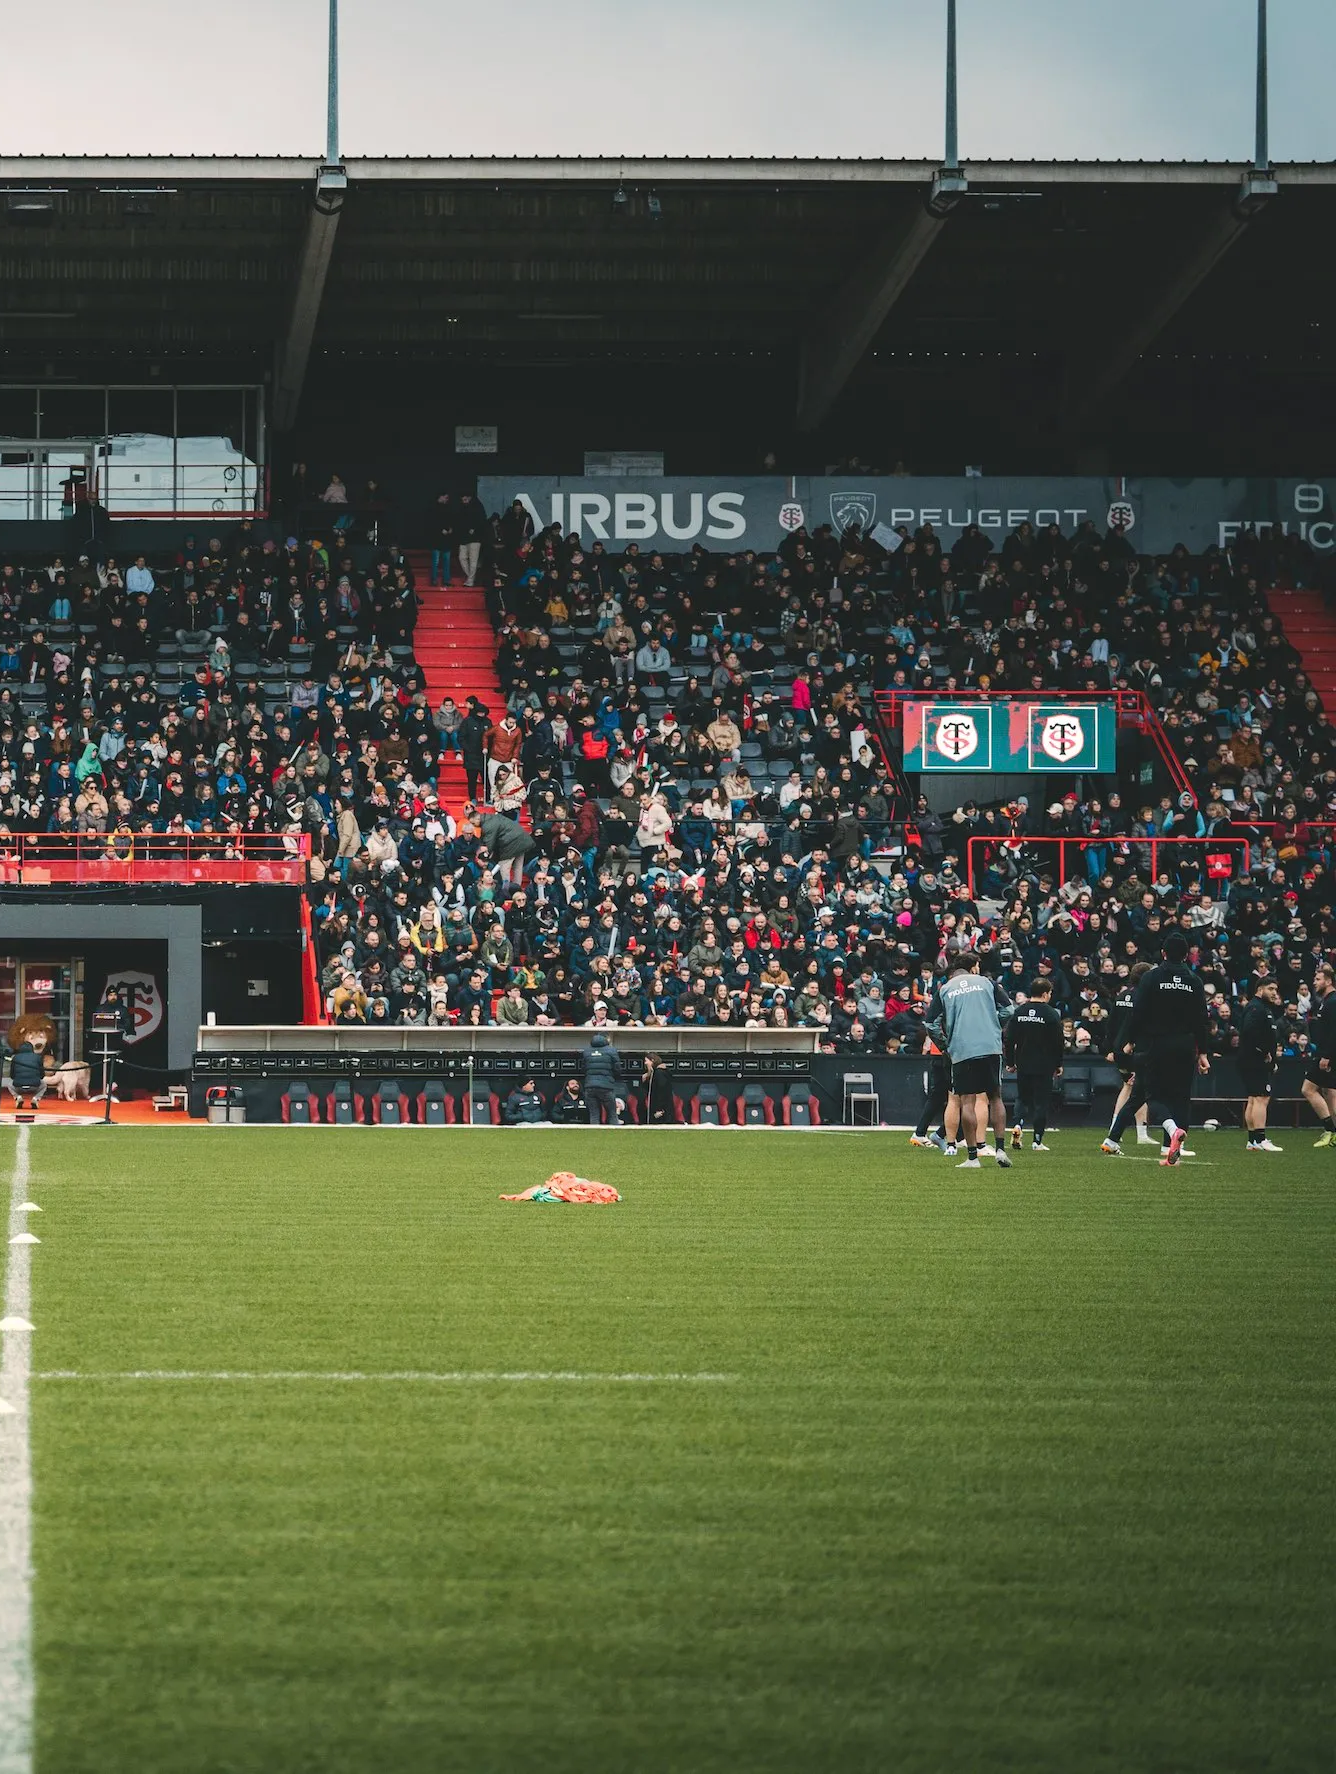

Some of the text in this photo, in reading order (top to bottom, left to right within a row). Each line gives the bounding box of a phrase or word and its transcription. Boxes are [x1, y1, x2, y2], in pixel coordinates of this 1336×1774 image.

[892, 508, 1087, 528] PEUGEOT
[947, 985, 983, 999] FIDUCIAL
[1159, 982, 1193, 993] FIDUCIAL
[1017, 1015, 1046, 1024] FIDUCIAL
